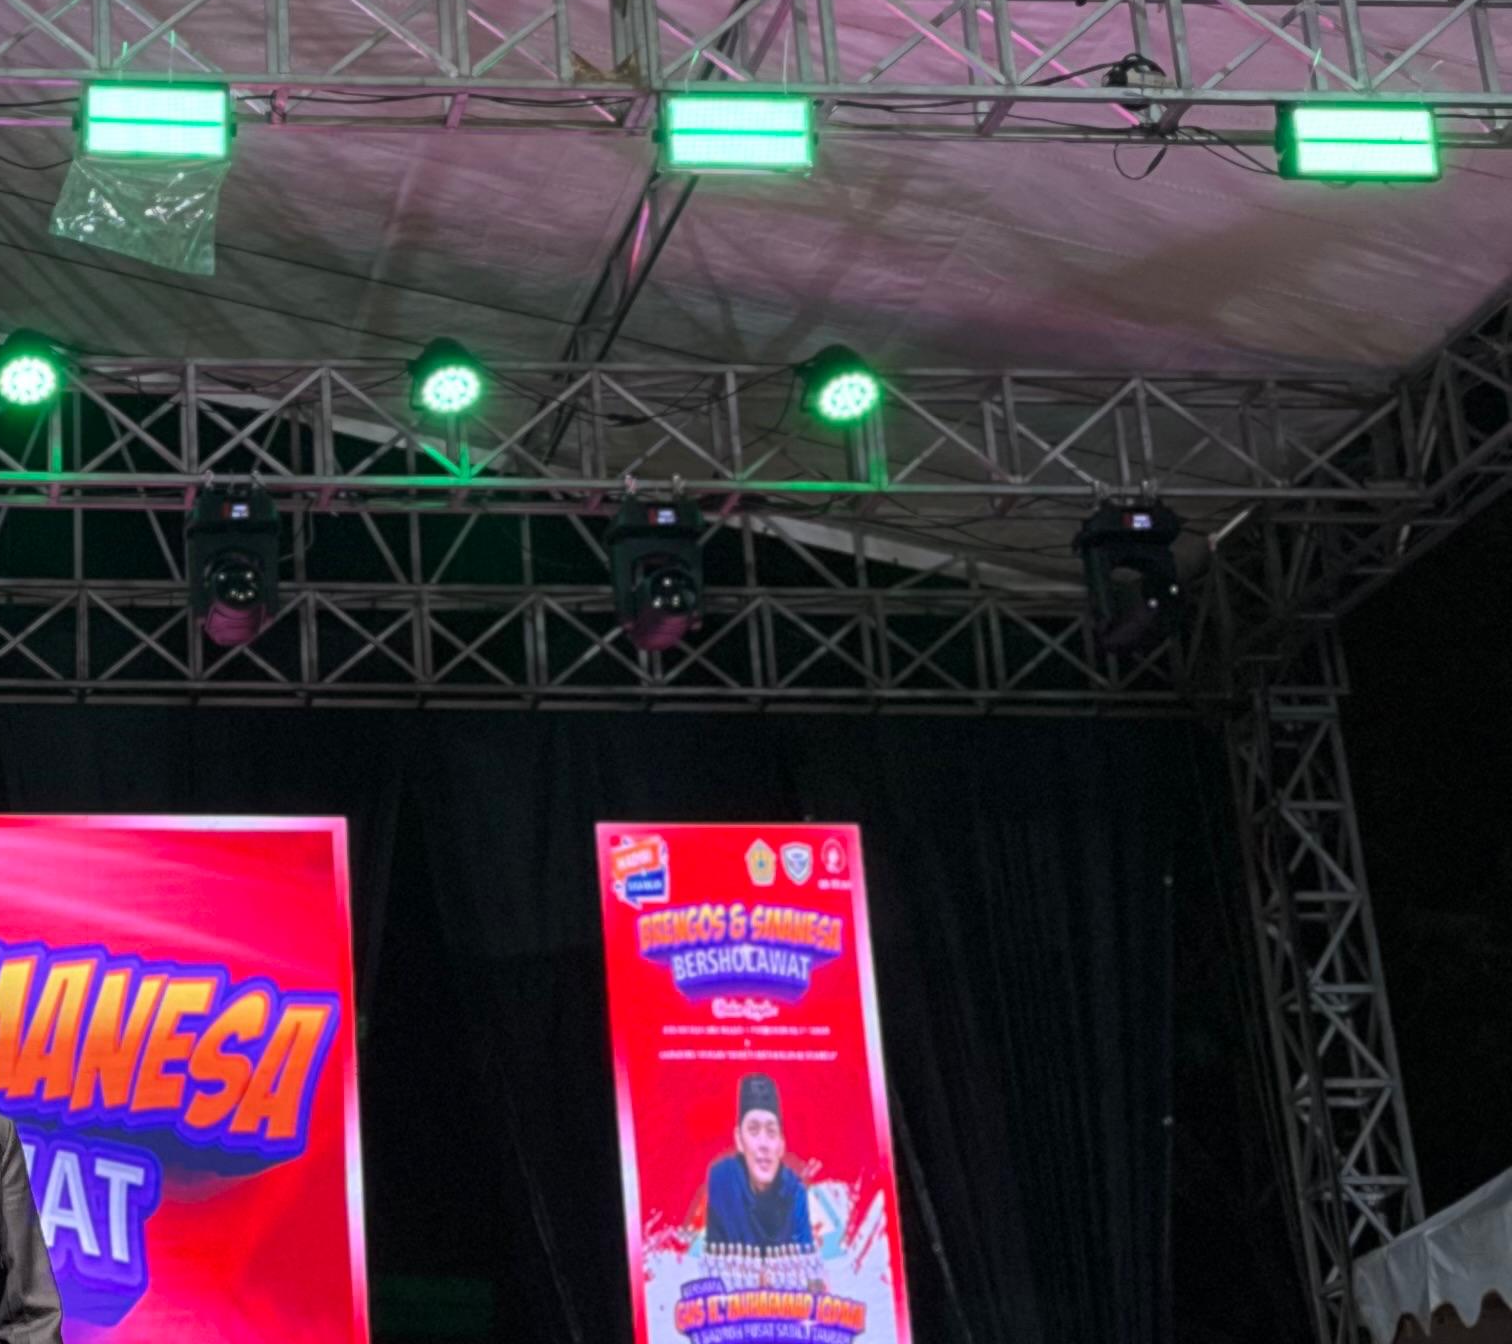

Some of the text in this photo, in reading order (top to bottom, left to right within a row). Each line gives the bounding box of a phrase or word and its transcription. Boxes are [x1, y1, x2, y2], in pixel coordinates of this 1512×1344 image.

[639, 903, 842, 951] BRENGOS & SMANESA
[672, 944, 811, 981] BERSHOLAWAT
